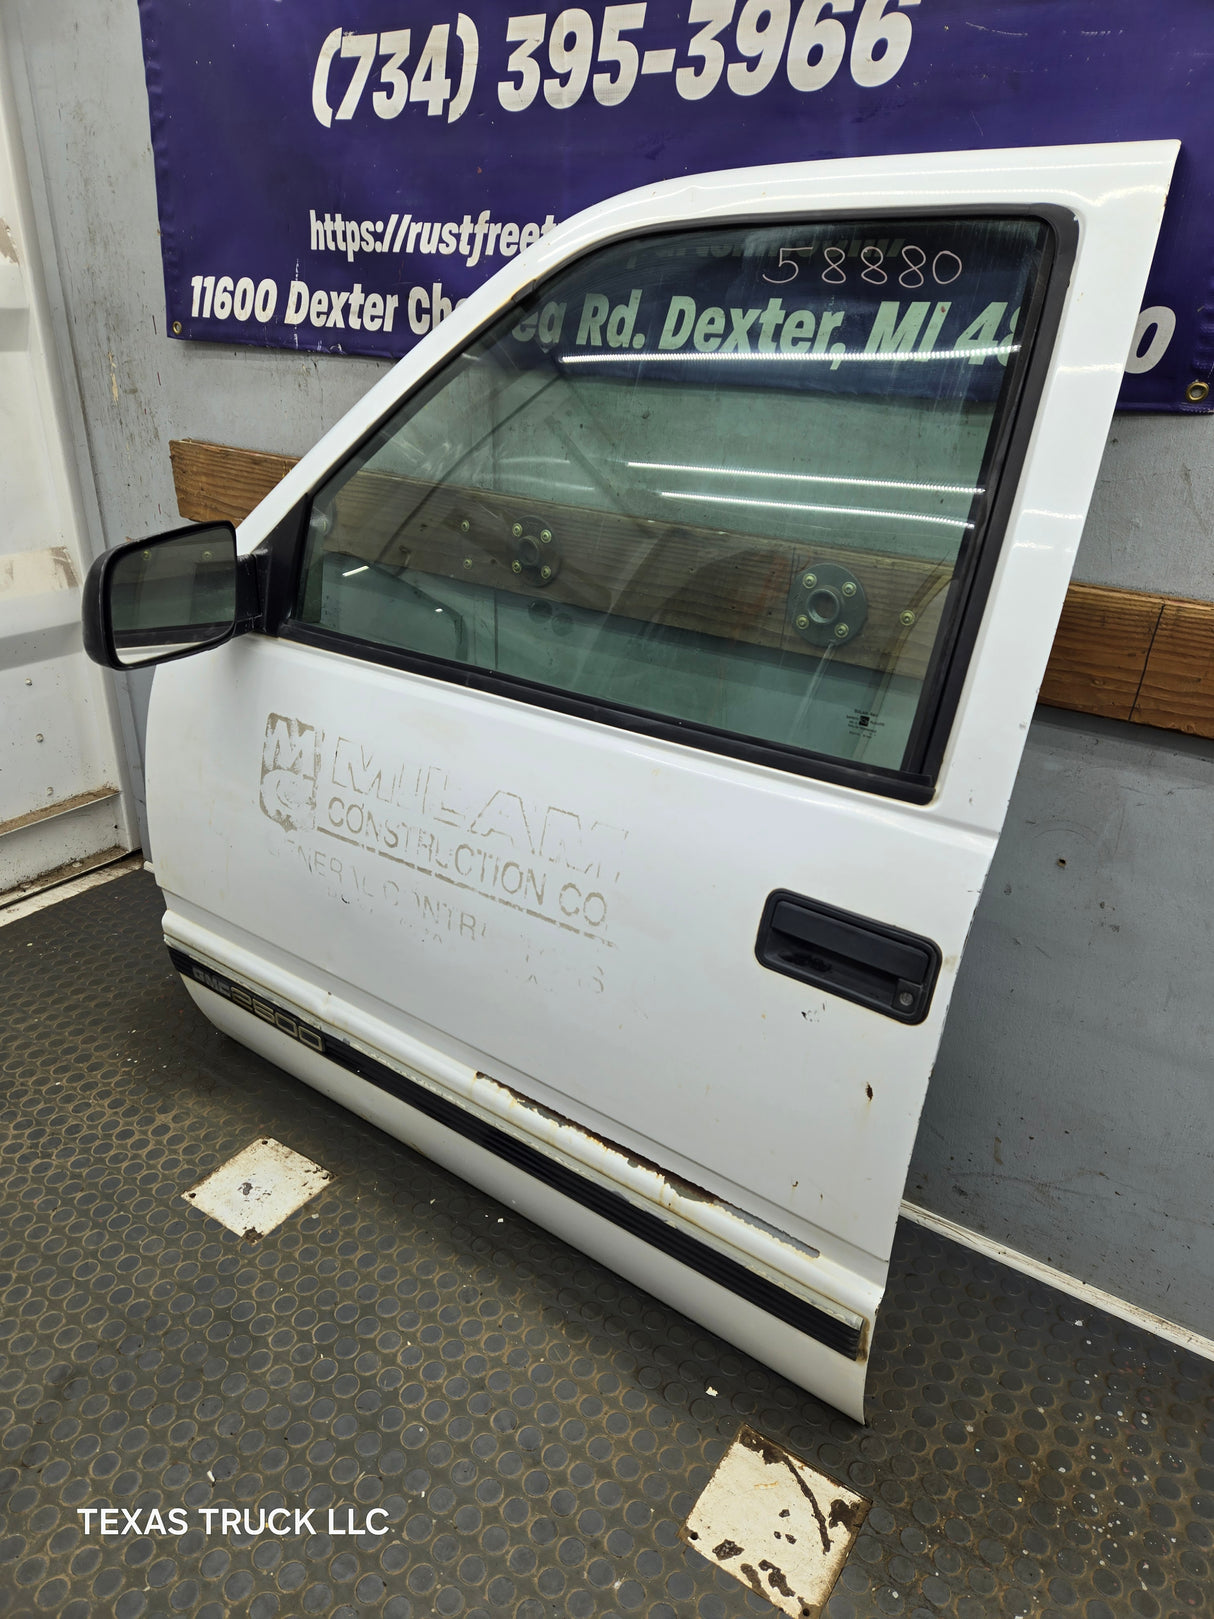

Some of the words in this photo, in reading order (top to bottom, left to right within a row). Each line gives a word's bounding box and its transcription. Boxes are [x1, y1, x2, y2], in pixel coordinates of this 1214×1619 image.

[311, 13, 479, 128] (734)
[498, 0, 920, 112] 395-3966
[309, 210, 562, 267] https://rustfree
[762, 245, 963, 288] 58880
[190, 276, 277, 323] 11600
[284, 280, 399, 333] Dexter
[576, 288, 645, 350] Rd.
[657, 295, 848, 370] Dexter,
[865, 301, 946, 363] MI
[328, 796, 548, 906] CONSTRUCTION
[192, 966, 231, 998] GMC
[231, 986, 324, 1052] 2500
